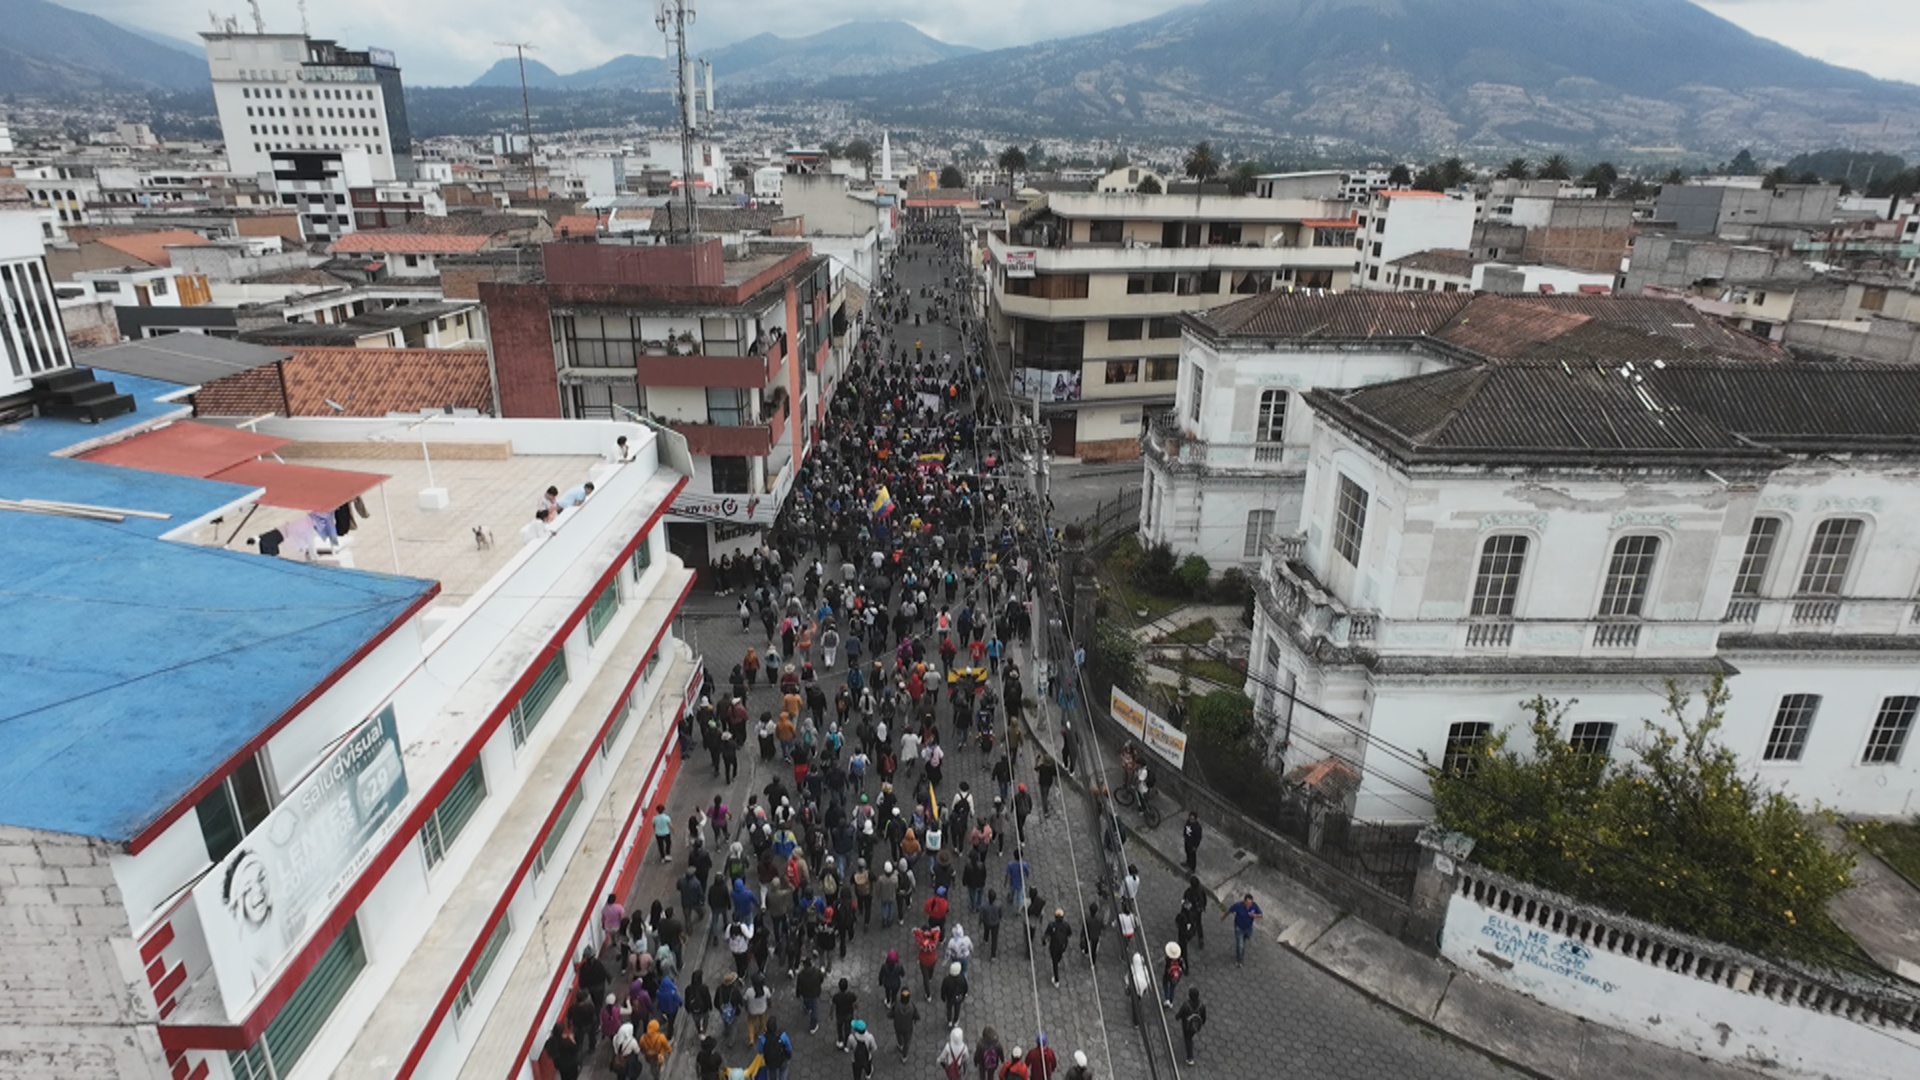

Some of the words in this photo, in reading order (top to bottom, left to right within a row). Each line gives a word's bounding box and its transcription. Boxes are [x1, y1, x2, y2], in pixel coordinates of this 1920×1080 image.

[302, 717, 384, 811] saludvisual
[276, 791, 352, 880] LENTES
[1481, 925, 1548, 958] ENCANTA
[1488, 915, 1521, 935] ELLA
[1527, 930, 1549, 944] ME
[1495, 941, 1516, 957] UN
